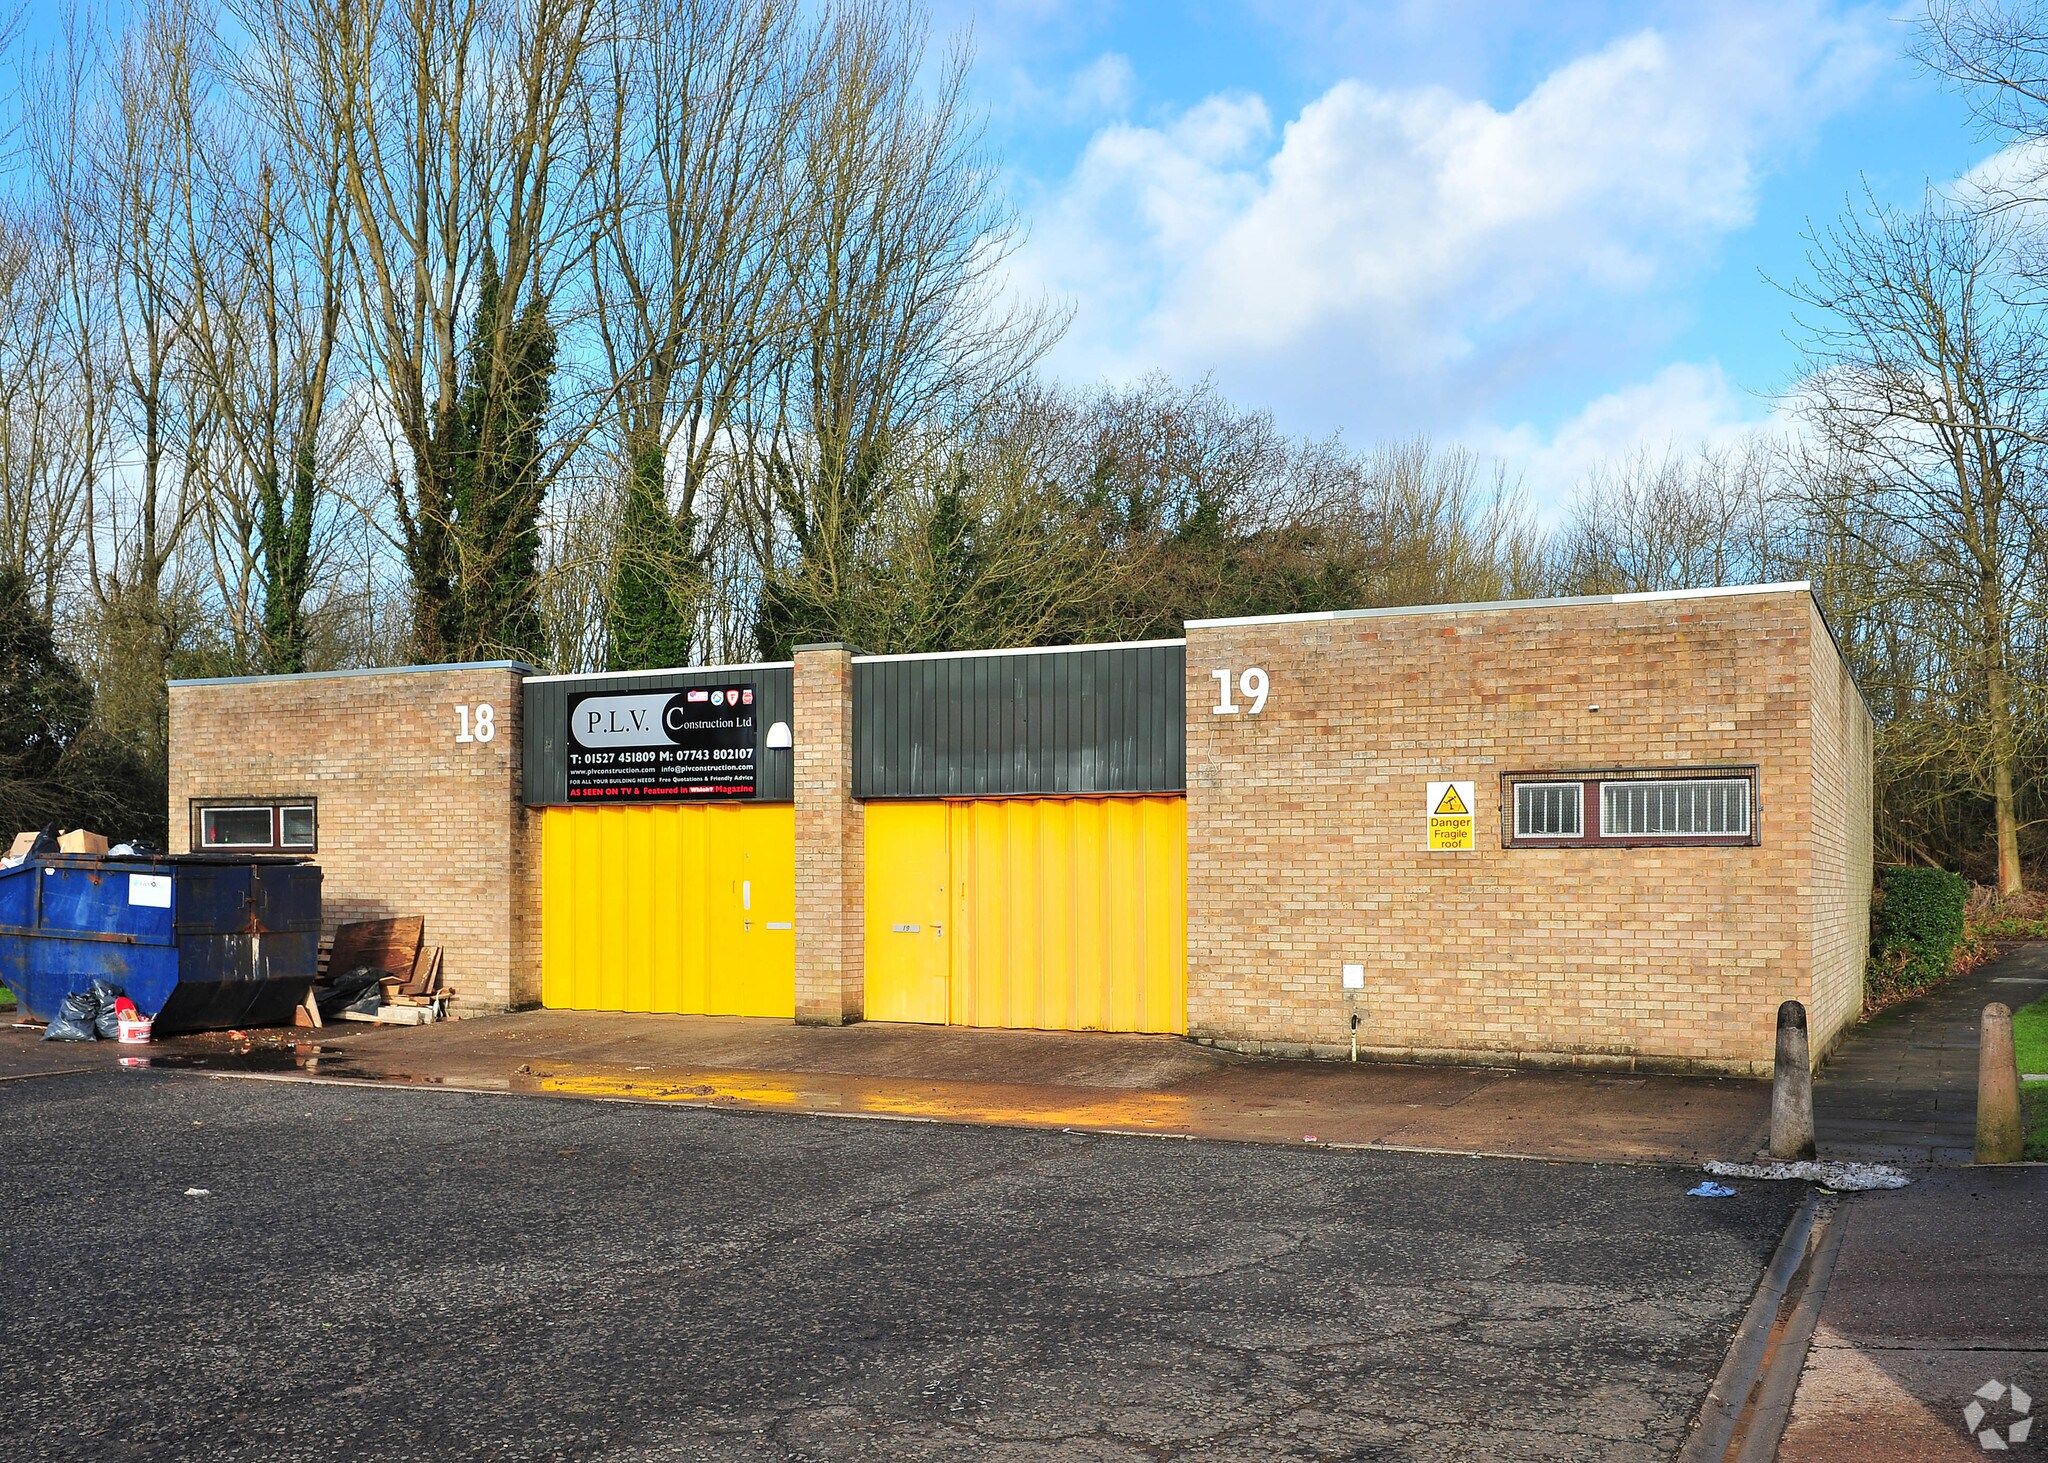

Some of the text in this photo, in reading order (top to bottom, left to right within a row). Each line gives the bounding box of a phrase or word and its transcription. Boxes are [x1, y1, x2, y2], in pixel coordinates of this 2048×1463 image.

[1211, 667, 1270, 715] 19
[455, 703, 495, 743] 18
[586, 706, 752, 734] P.L.V. Construction Ltd
[570, 748, 754, 765] T: 01527 451809 M: 07743 802107
[570, 764, 754, 776] www.plvconstruction.com info@plvconstruction.com
[570, 788, 581, 796] AS
[582, 788, 604, 796] SEEN
[605, 787, 619, 795] ON
[620, 787, 632, 795] TV
[633, 787, 640, 795] &
[643, 786, 679, 795] Featured
[680, 786, 688, 794] in
[715, 785, 754, 795] Magazine
[1431, 817, 1471, 829] Danger
[1434, 829, 1468, 840] Fragile
[1441, 839, 1462, 849] roof
